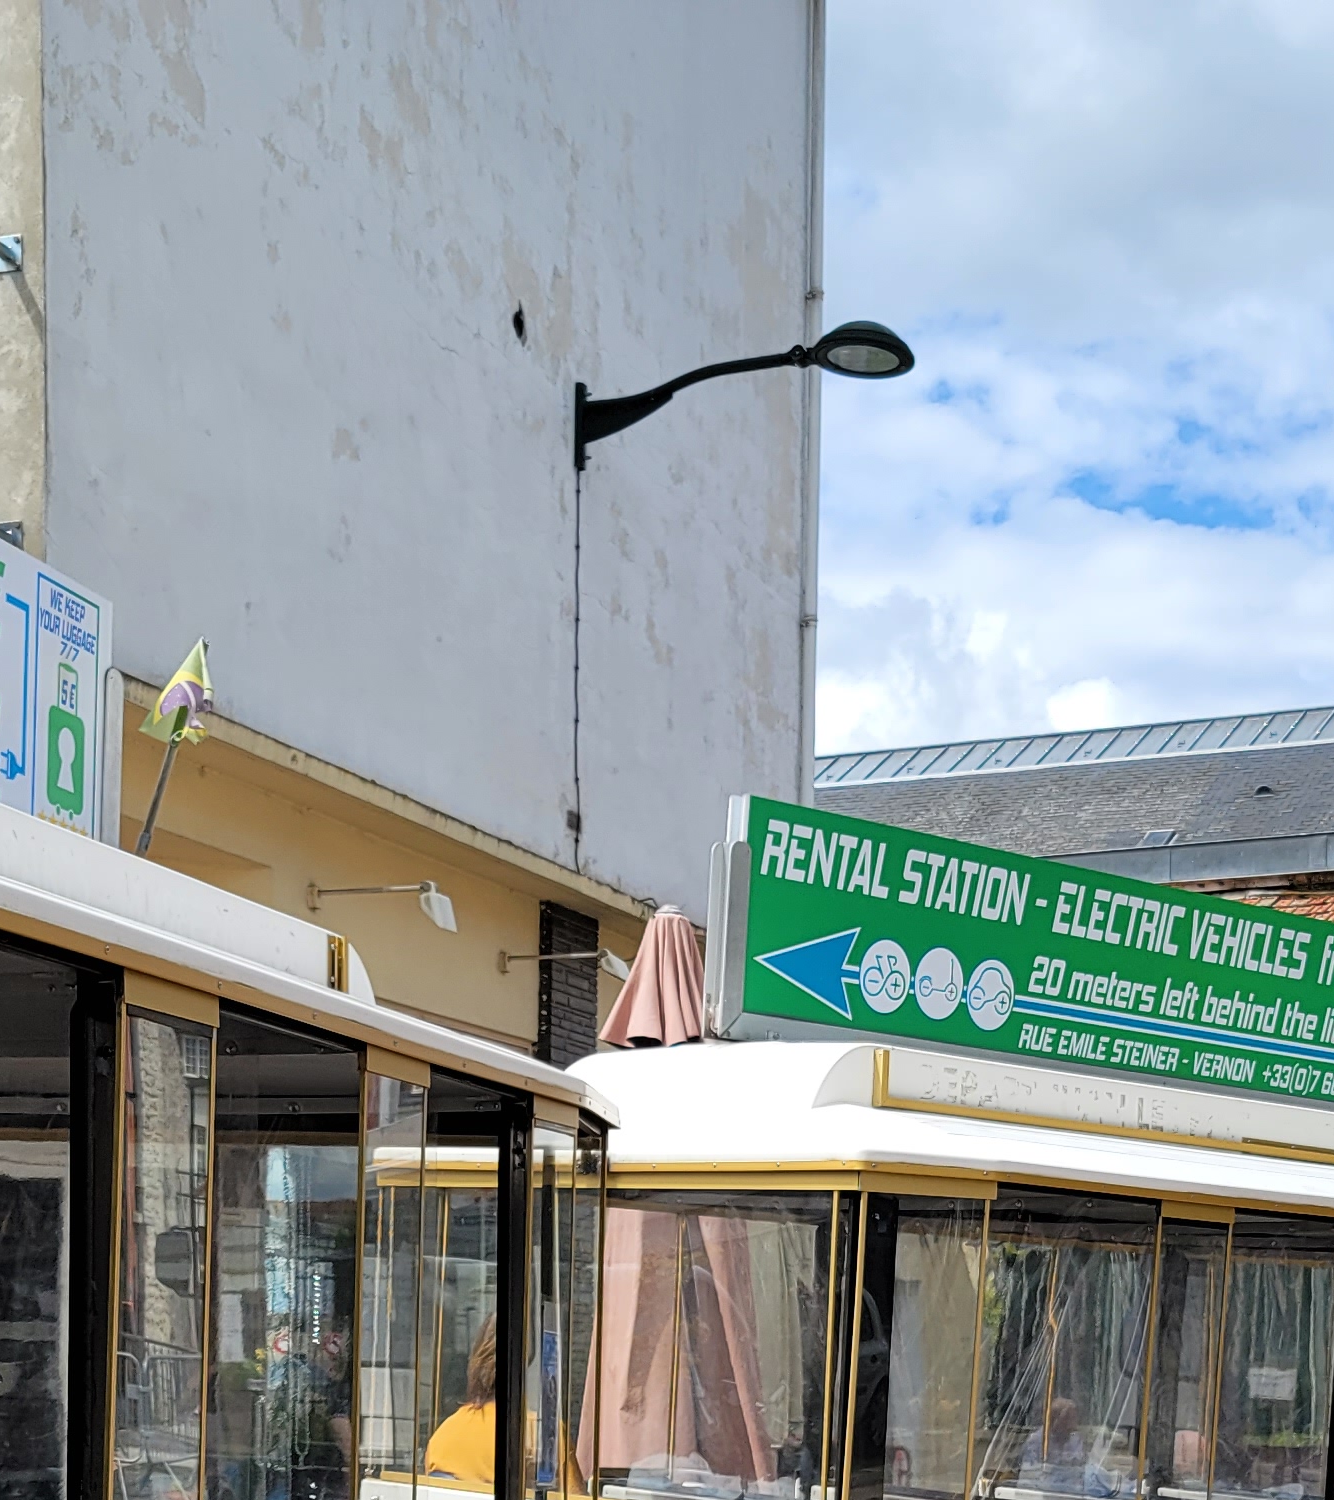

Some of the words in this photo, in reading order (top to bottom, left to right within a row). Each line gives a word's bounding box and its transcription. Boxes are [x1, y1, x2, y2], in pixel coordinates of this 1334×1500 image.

[40, 607, 60, 636] YOUR
[61, 619, 96, 655] LUGGAGE
[50, 588, 64, 613] WE
[65, 595, 86, 623] KEEP
[60, 641, 79, 662] 7/7
[760, 819, 889, 899] RENTAL
[898, 848, 1031, 925] STATION
[1052, 881, 1186, 956] ELECTRIC
[1189, 909, 1311, 980] VEHICLES
[1028, 956, 1066, 996] 20
[1067, 972, 1157, 1012] meters
[1159, 977, 1199, 1020] left
[1200, 985, 1281, 1034] behind
[1281, 1001, 1318, 1040] the
[1018, 1024, 1057, 1052] RUE
[1058, 1031, 1110, 1060] EMILE
[1110, 1039, 1180, 1072] STEINER
[1193, 1051, 1257, 1083] VERNON
[1262, 1063, 1321, 1095] +33(0)7
